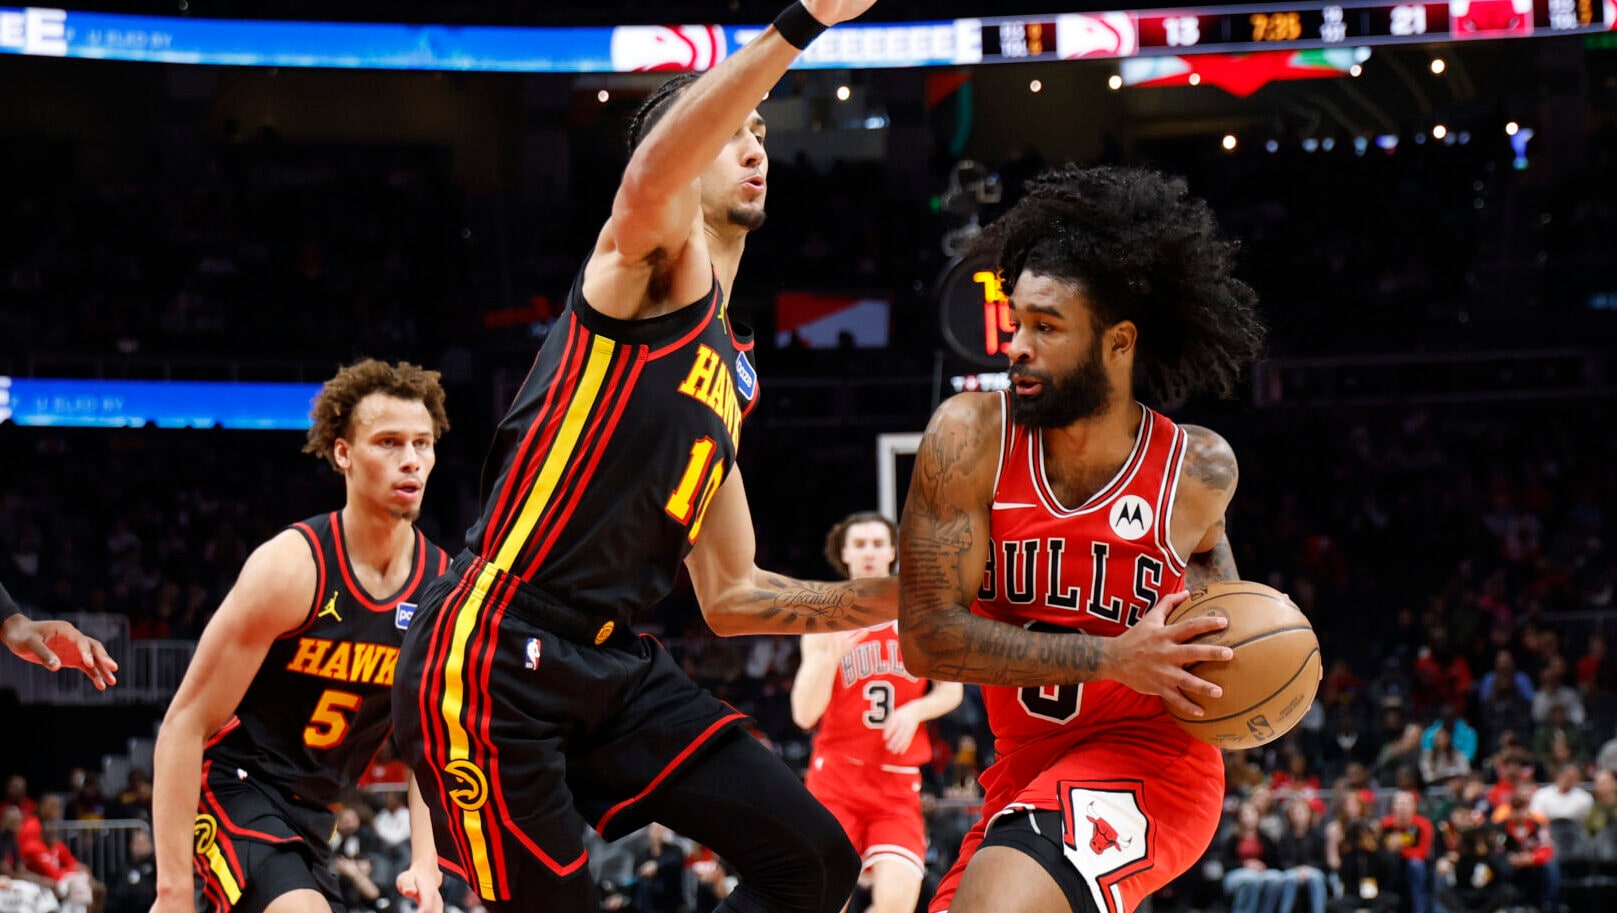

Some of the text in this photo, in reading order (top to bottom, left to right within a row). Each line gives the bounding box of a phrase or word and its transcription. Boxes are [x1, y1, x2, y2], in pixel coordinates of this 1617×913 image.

[1162, 16, 1200, 46] 13
[1390, 5, 1426, 36] 21
[677, 342, 743, 460] HAWK
[664, 435, 725, 545] 10
[286, 637, 401, 687] HAWK
[839, 639, 907, 690] BULL
[303, 689, 364, 750] 5
[862, 680, 895, 730] 3
